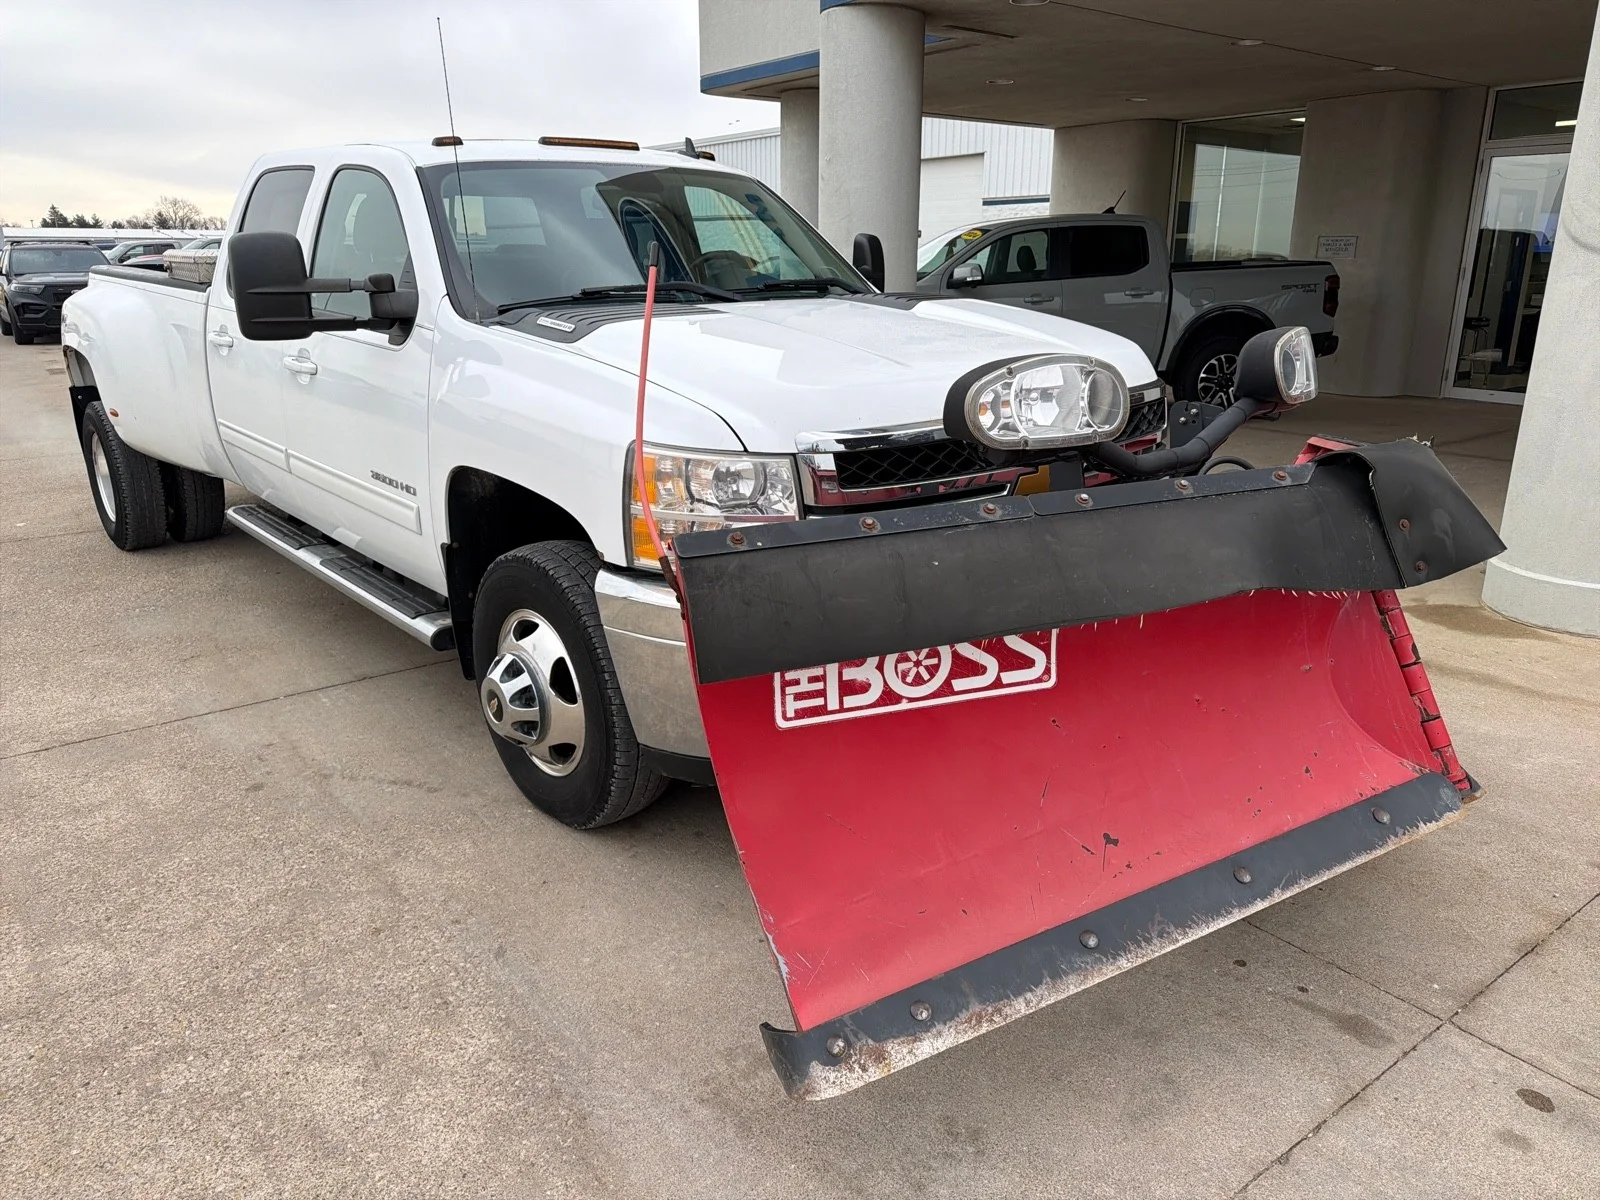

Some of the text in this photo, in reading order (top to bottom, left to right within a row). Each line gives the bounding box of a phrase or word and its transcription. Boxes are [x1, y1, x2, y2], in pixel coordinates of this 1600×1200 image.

[400, 482, 417, 497] HD
[784, 634, 1047, 718] TH BOSS
